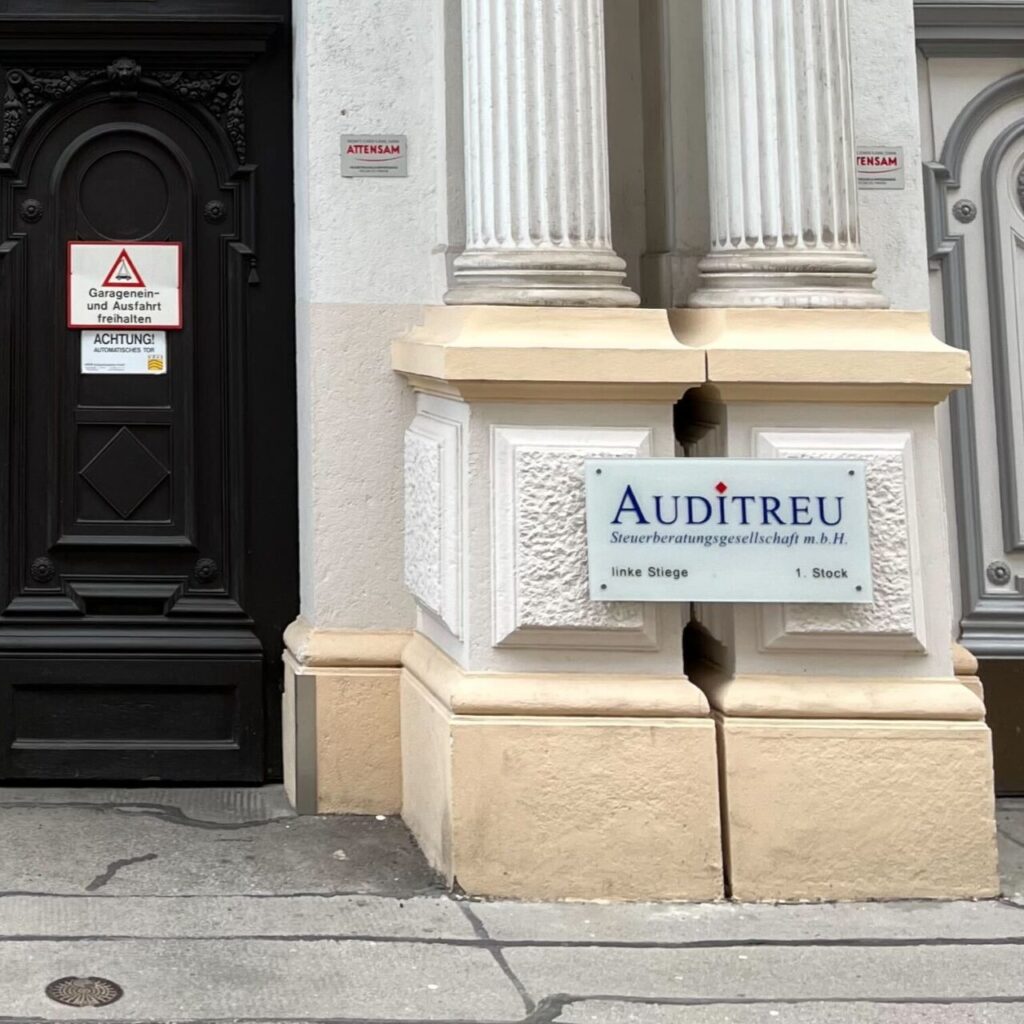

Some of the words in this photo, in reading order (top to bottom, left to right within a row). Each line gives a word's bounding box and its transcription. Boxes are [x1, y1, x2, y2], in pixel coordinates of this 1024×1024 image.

[346, 144, 400, 154] ATTENSAM
[88, 287, 160, 300] Garagenein-
[87, 301, 108, 311] und
[112, 301, 162, 311] Ausfahrt
[97, 313, 152, 324] freihalten
[93, 333, 155, 345] ACHTUNG!
[610, 530, 799, 547] Steuerberatungsgesellschaft
[803, 532, 848, 546] m.b.H.
[611, 566, 642, 577] linke
[647, 567, 689, 580] Stiege
[795, 568, 807, 578] 1.
[812, 567, 849, 579] Stock
